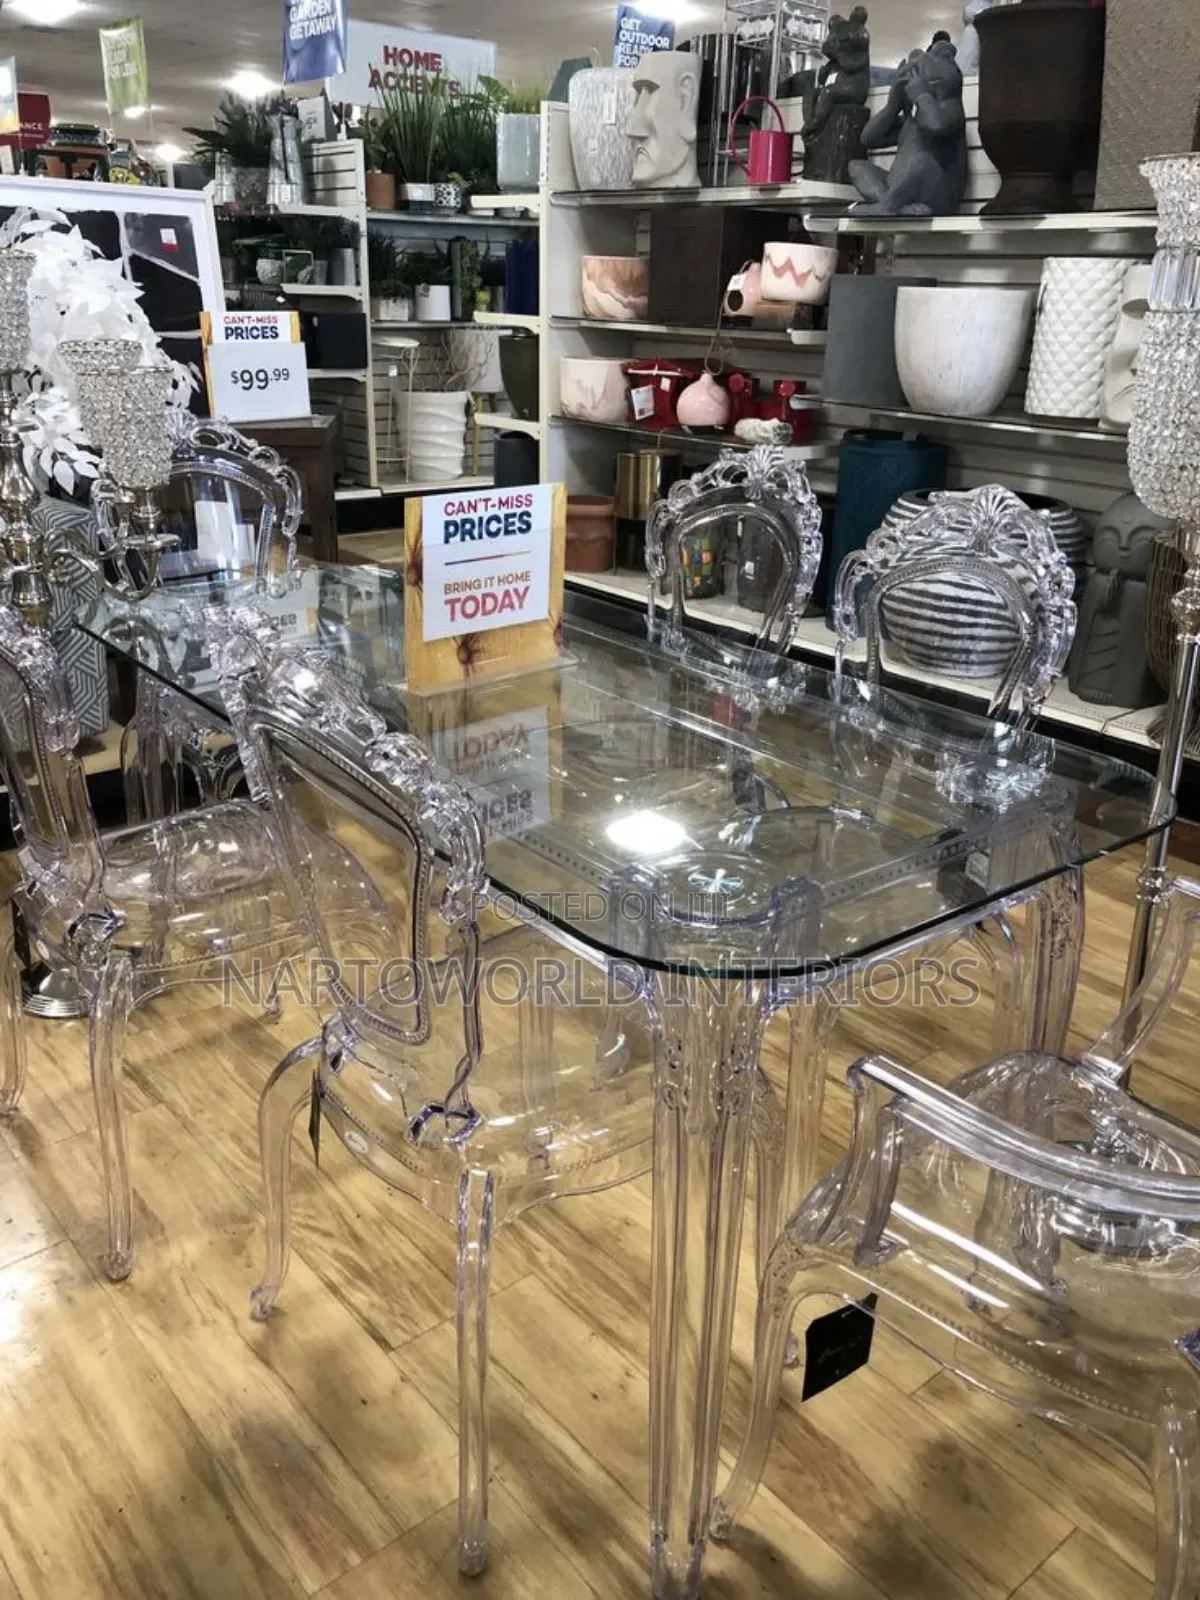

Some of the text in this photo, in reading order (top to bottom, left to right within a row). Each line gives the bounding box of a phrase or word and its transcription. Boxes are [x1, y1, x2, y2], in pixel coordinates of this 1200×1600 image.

[290, 15, 337, 39] GETAWAY
[620, 17, 641, 31] GET
[619, 29, 670, 49] OUTDOOR
[383, 45, 443, 73] HOME
[223, 315, 278, 325] CAN'T-MISS
[224, 325, 279, 340] PRICES
[230, 367, 290, 391] $99.99
[443, 493, 533, 517] CAN'T-MISS
[443, 510, 533, 544] PRICES
[444, 570, 531, 595] BRING IT HOME
[444, 585, 530, 623] TODAY
